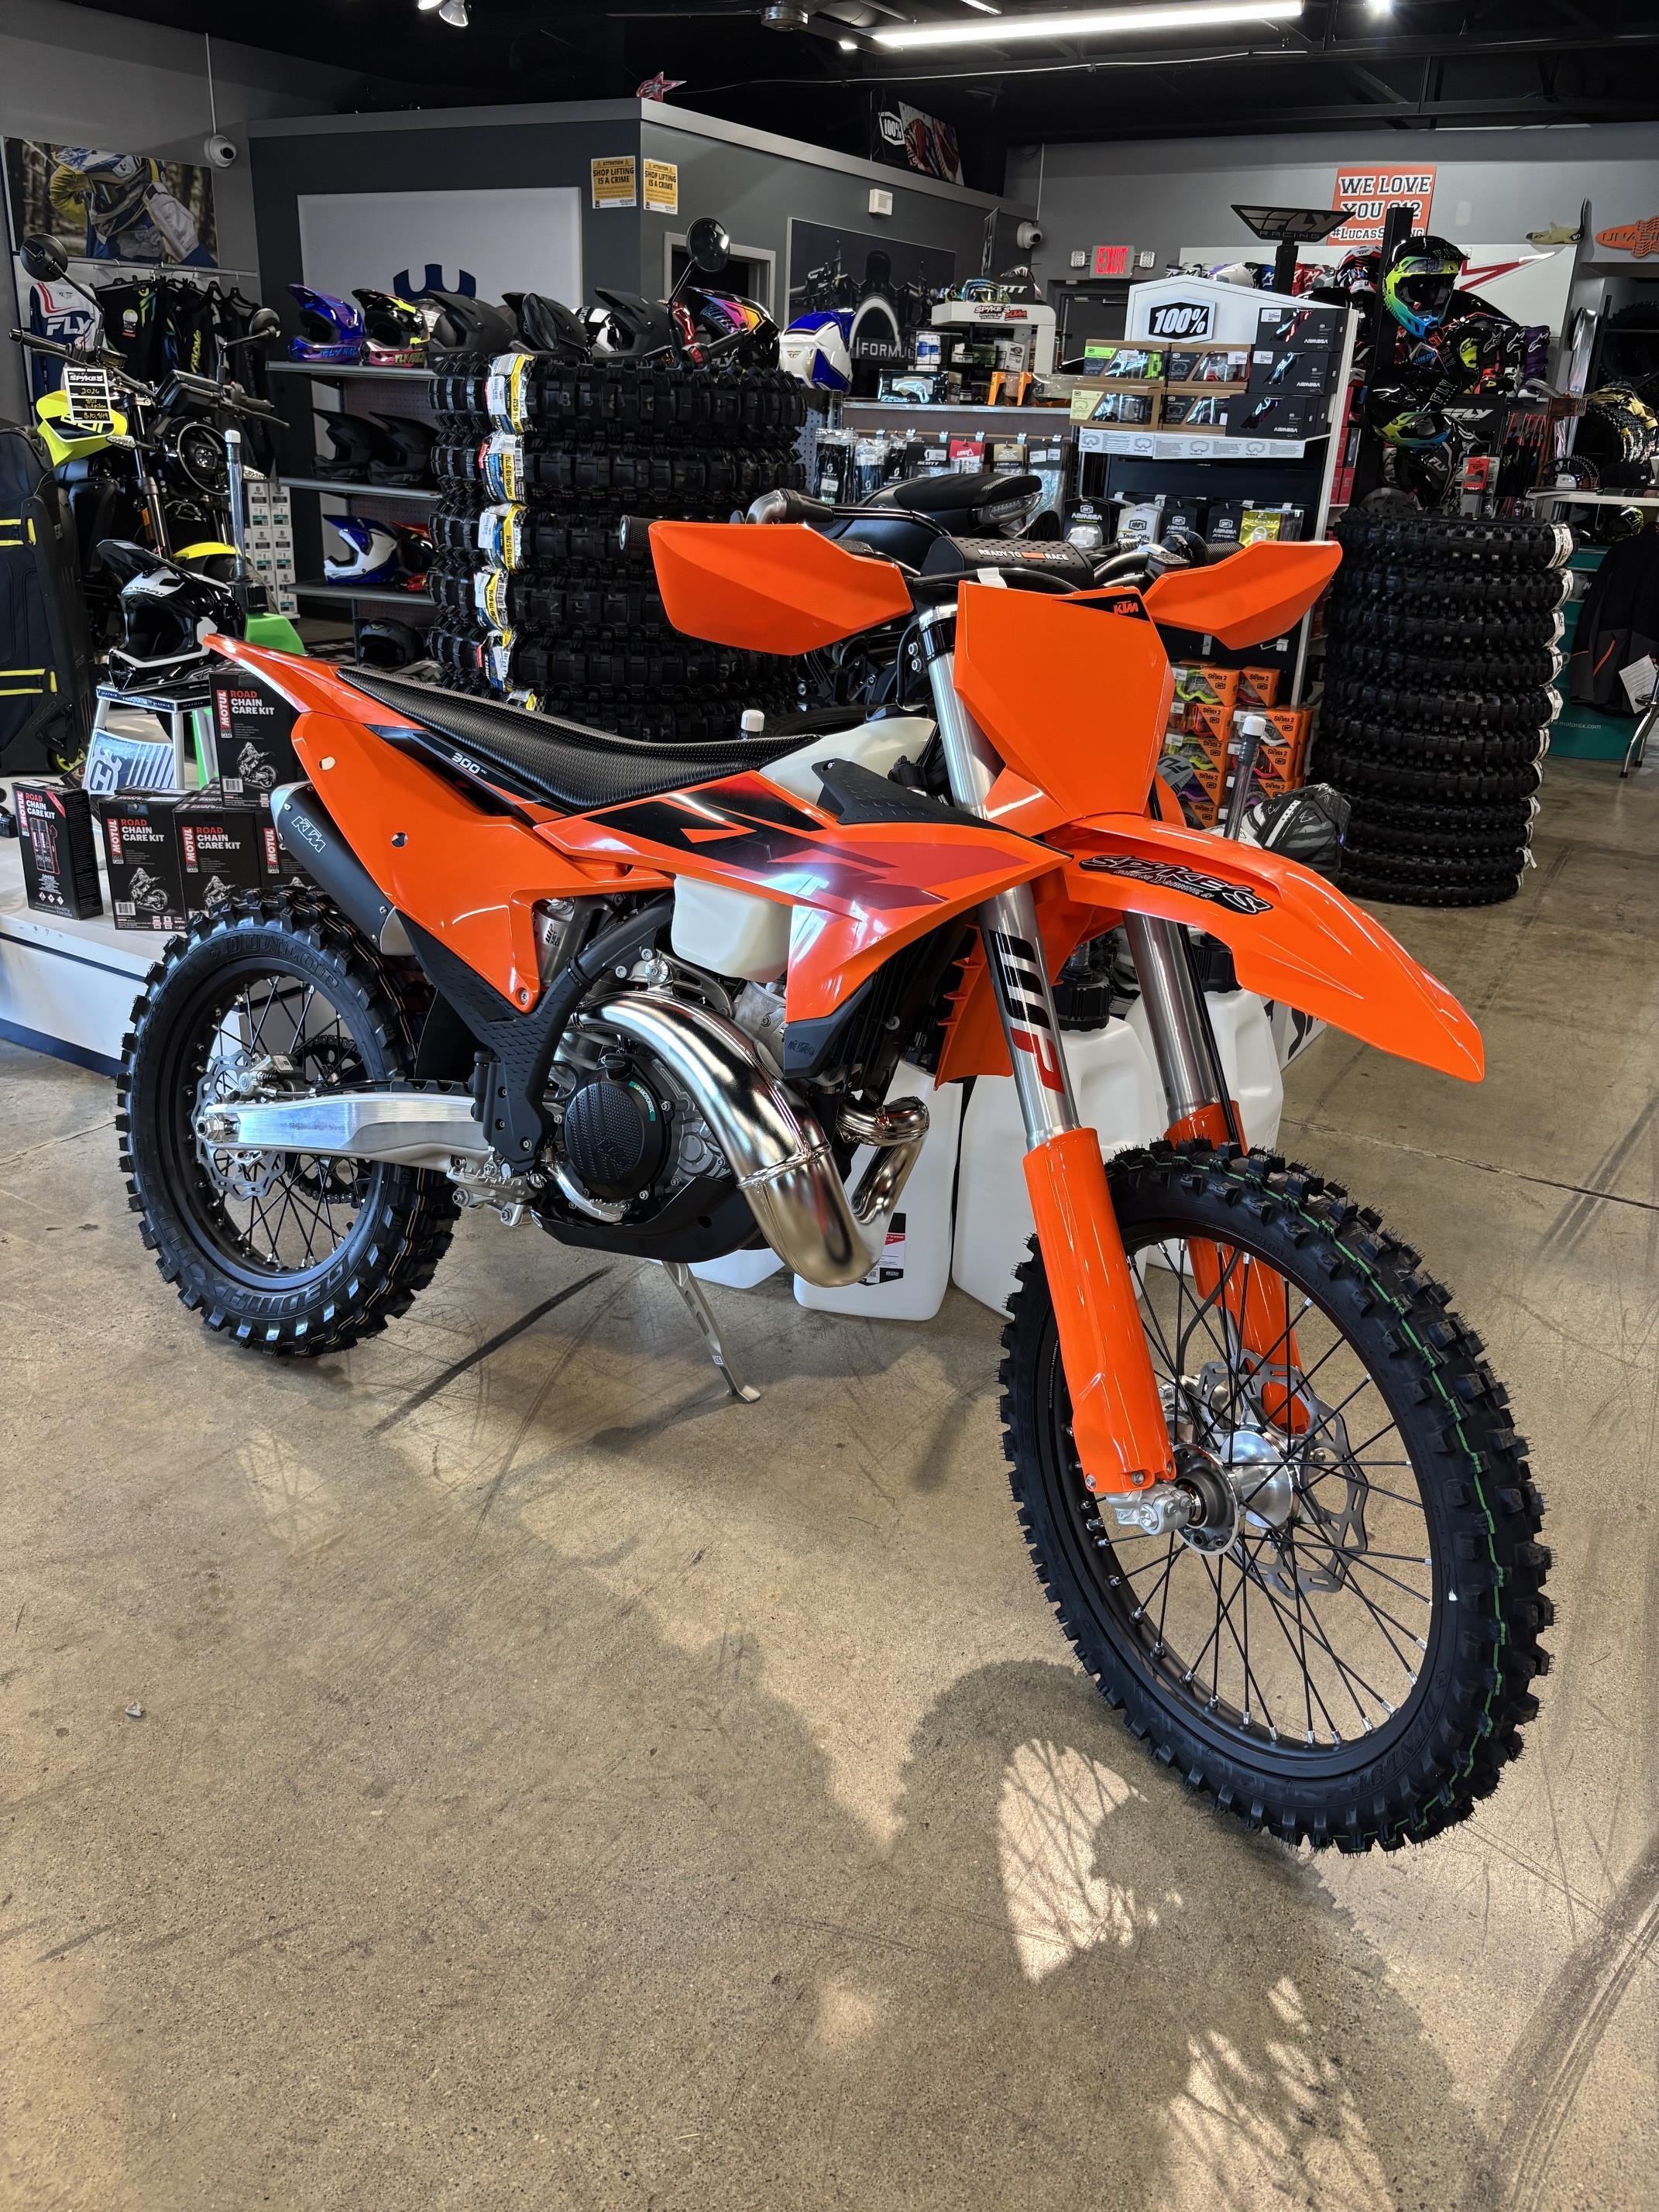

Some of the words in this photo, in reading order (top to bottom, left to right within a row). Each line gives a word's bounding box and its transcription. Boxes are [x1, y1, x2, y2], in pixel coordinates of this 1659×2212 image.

[884, 118, 902, 139] 100%
[644, 170, 658, 179] SHOP
[658, 173, 676, 183] LIFTING
[658, 182, 673, 191] CRIME
[1340, 177, 1376, 195] WE
[1379, 175, 1433, 194] LOVE
[1239, 209, 1345, 232] FLY
[1341, 201, 1386, 221] YOU
[1259, 230, 1321, 239] RACING
[1097, 247, 1128, 274] EXIT
[46, 316, 95, 336] FLY
[1152, 307, 1208, 334] 100%
[321, 348, 342, 359] FLY
[1441, 407, 1494, 421] FLY
[978, 548, 1008, 558] READY
[1045, 552, 1069, 561] RACE
[1113, 600, 1139, 616] KTM
[218, 692, 231, 727] MOTUL
[231, 698, 263, 706] CHAIN
[452, 752, 480, 774] 300
[25, 793, 43, 802] ROAD
[26, 800, 47, 810] CHAIN
[18, 792, 29, 828] MOTUL
[27, 809, 44, 818] CARE
[44, 811, 56, 819] KIT
[108, 819, 122, 854] MOTUL
[291, 816, 326, 853] KTM
[184, 829, 196, 863] MOTUL
[265, 830, 277, 863] MOTUL
[1081, 856, 1271, 913] SPYKE'S
[223, 933, 340, 988] DUNLOP
[988, 929, 1065, 1094] WP
[640, 1088, 654, 1112] MOTOREX
